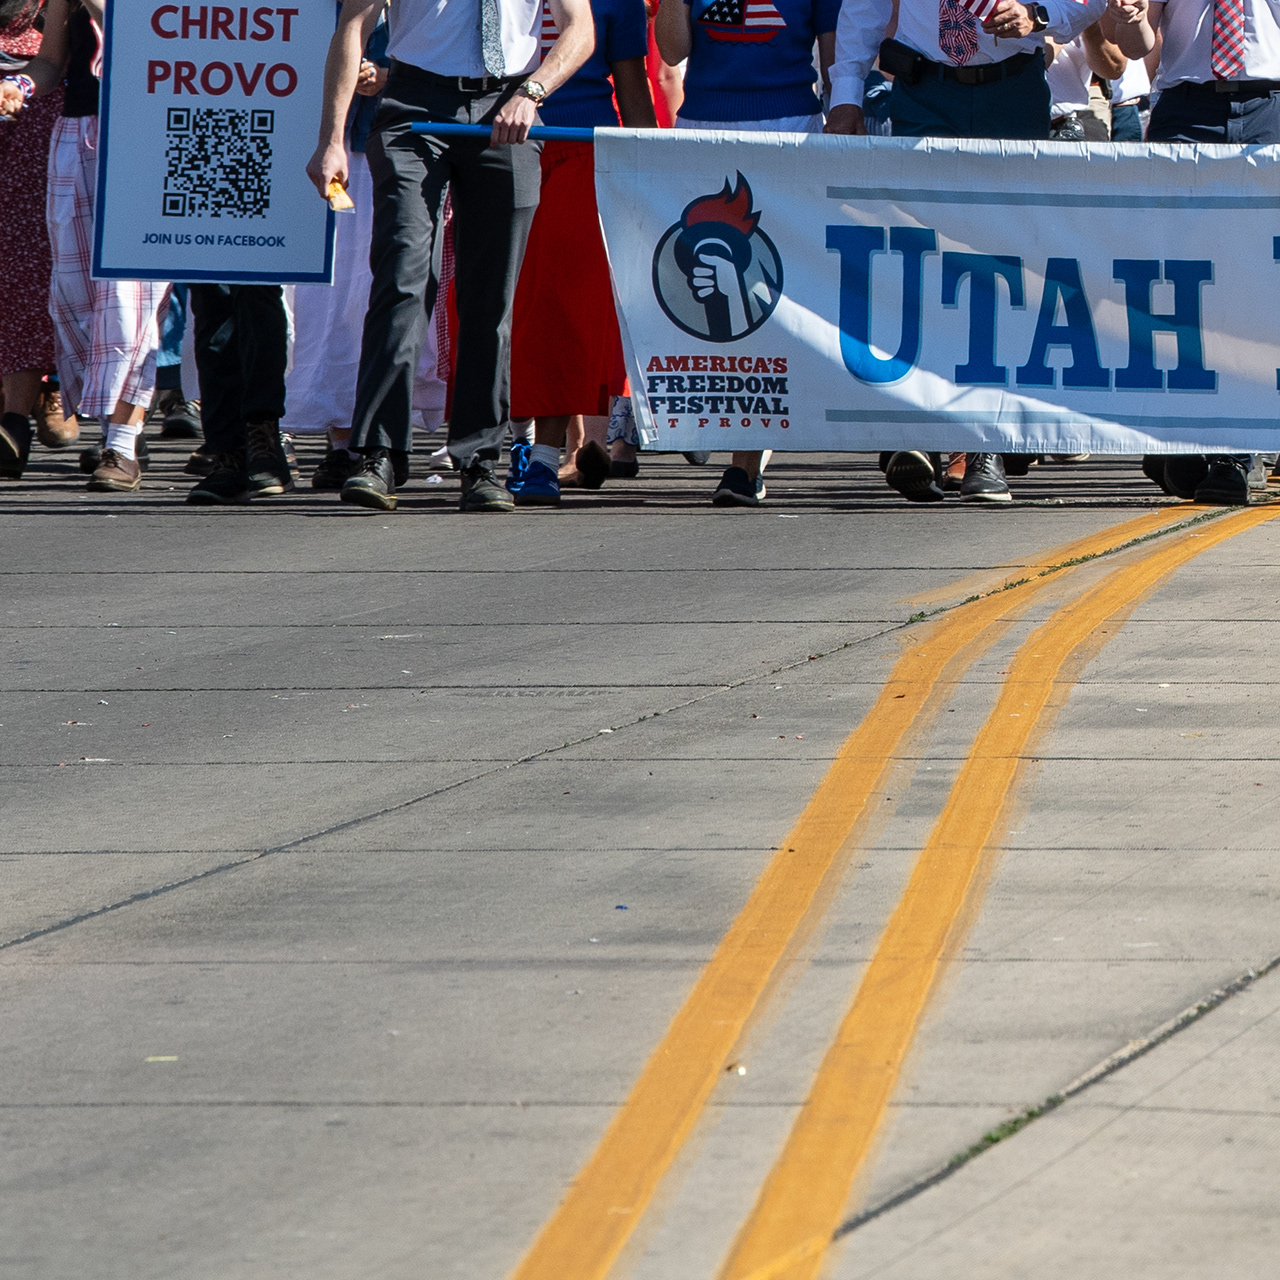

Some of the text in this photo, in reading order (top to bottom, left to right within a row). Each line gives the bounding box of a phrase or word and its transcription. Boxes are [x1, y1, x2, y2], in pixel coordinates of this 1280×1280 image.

[151, 5, 299, 42] CHRIST
[147, 60, 299, 97] PROVO
[142, 233, 286, 248] JOIN US ON FACEBOOK
[825, 224, 1218, 391] UTAH
[646, 355, 788, 374] AMERICA'S
[647, 375, 789, 394] FREEDOM
[648, 395, 789, 415] FESTIVAL
[698, 417, 790, 429] PROVO
